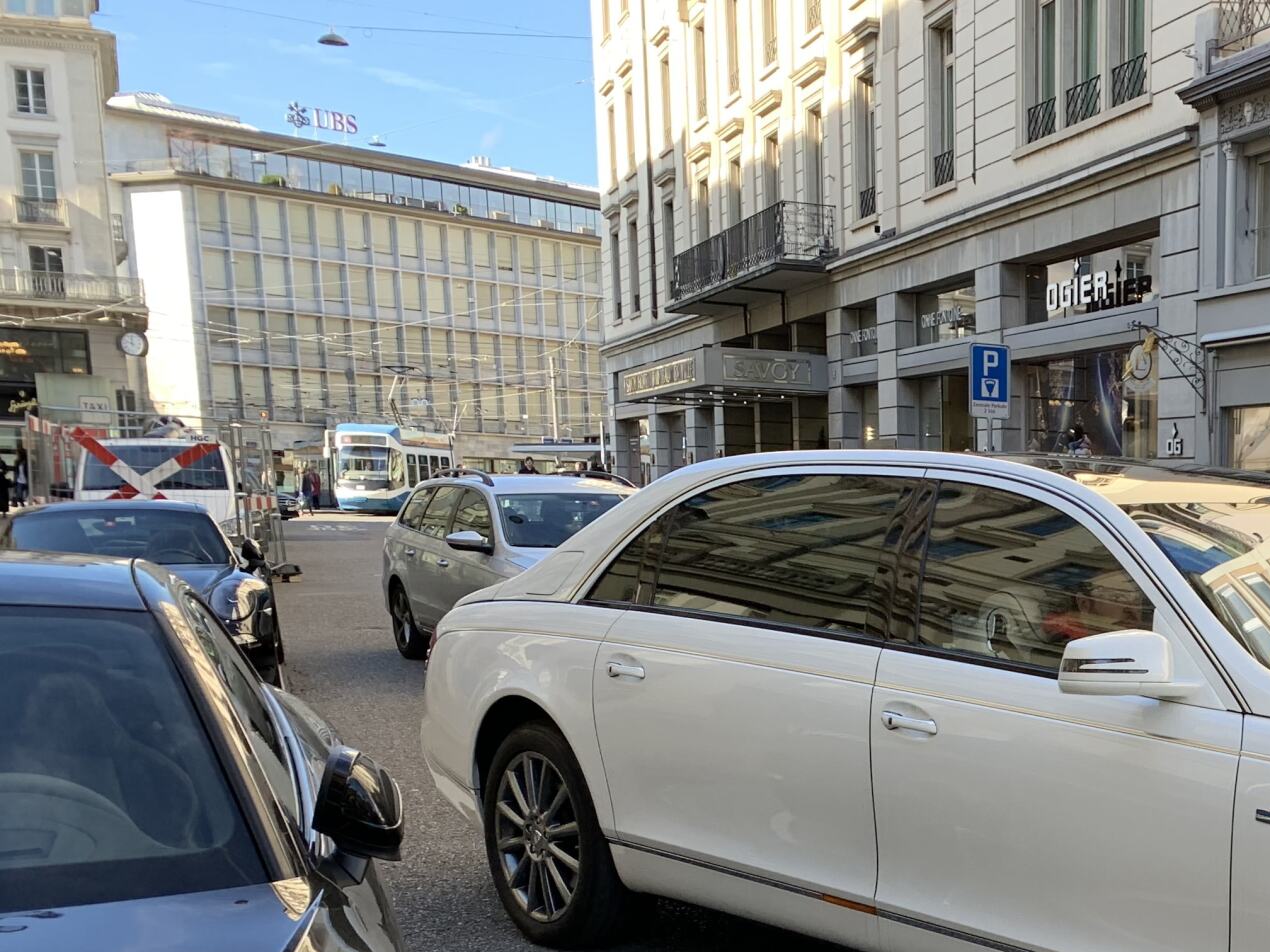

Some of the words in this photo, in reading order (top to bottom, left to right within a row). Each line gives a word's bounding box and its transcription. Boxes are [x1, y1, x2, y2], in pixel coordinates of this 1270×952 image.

[313, 108, 358, 135] UBS
[1046, 270, 1109, 311] OGIER
[735, 361, 800, 380] SAVOY
[983, 350, 999, 377] P
[82, 402, 108, 411] TAXI
[1165, 438, 1183, 455] OG
